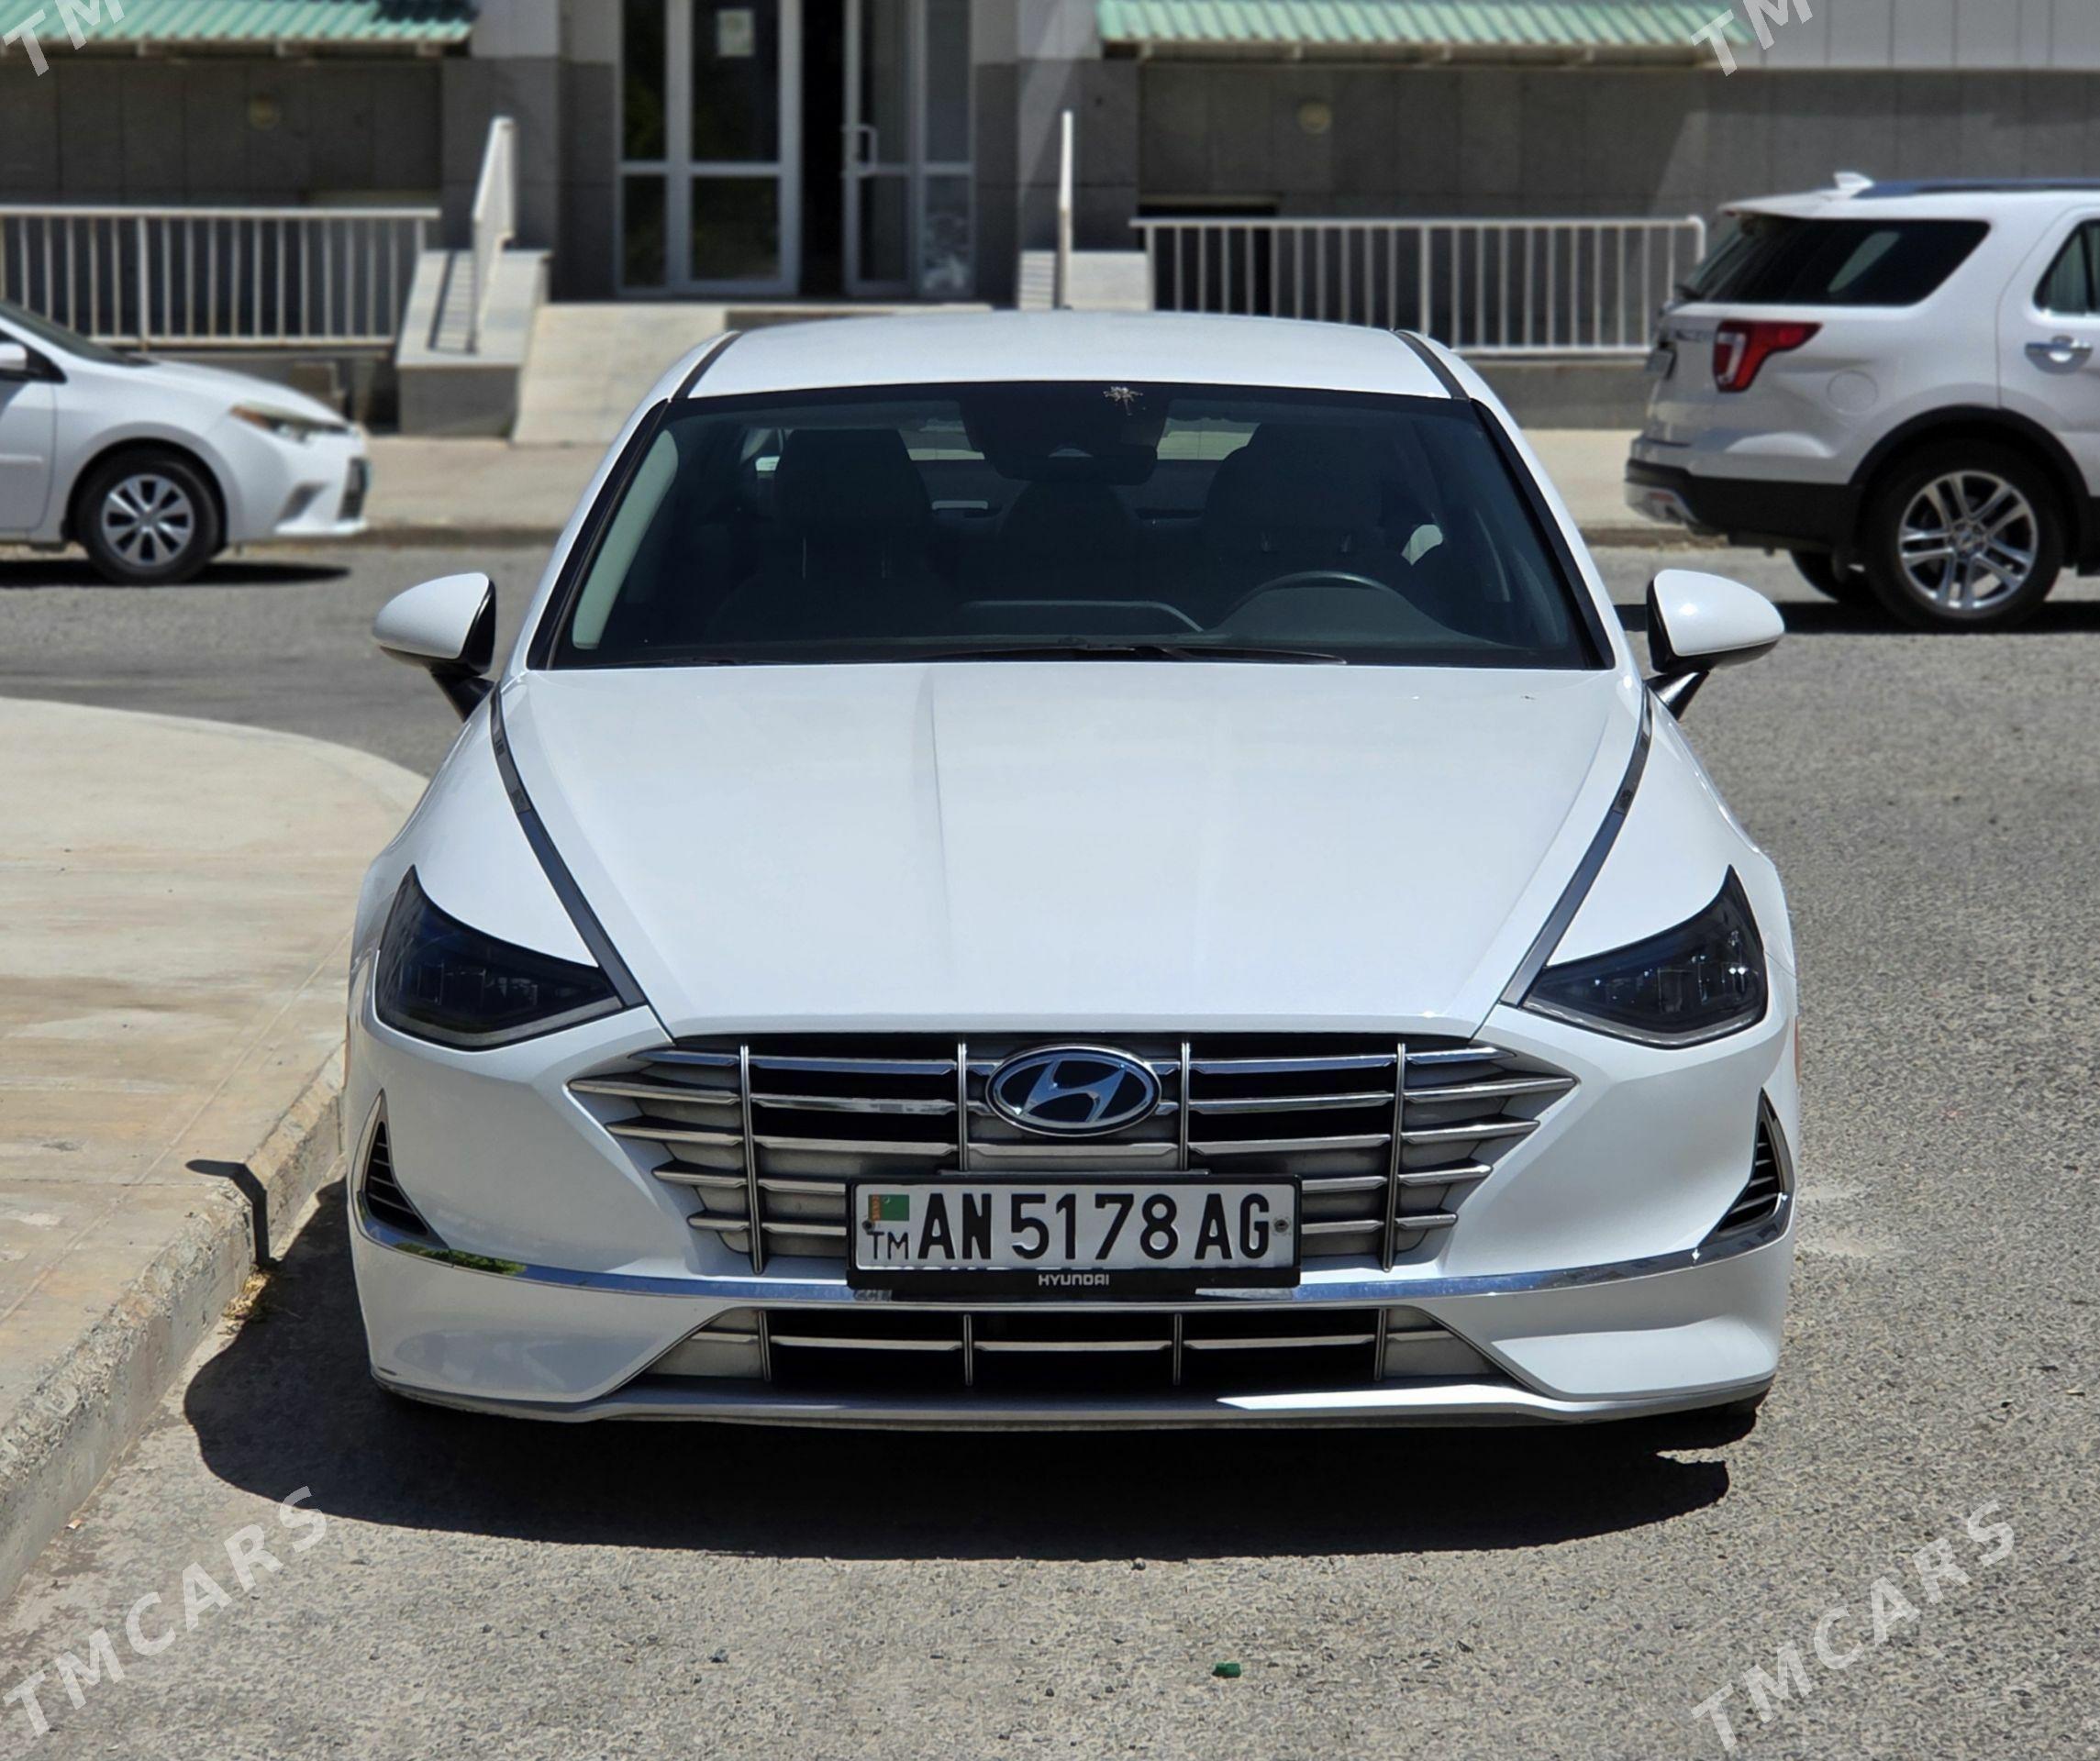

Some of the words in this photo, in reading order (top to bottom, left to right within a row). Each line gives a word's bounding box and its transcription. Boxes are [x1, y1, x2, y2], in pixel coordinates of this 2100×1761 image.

[917, 1193, 992, 1260] AN
[1011, 1193, 1179, 1260] 5178
[1194, 1193, 1270, 1260] AG
[866, 1231, 909, 1260] TM
[1038, 1273, 1110, 1286] HYUNDAI
